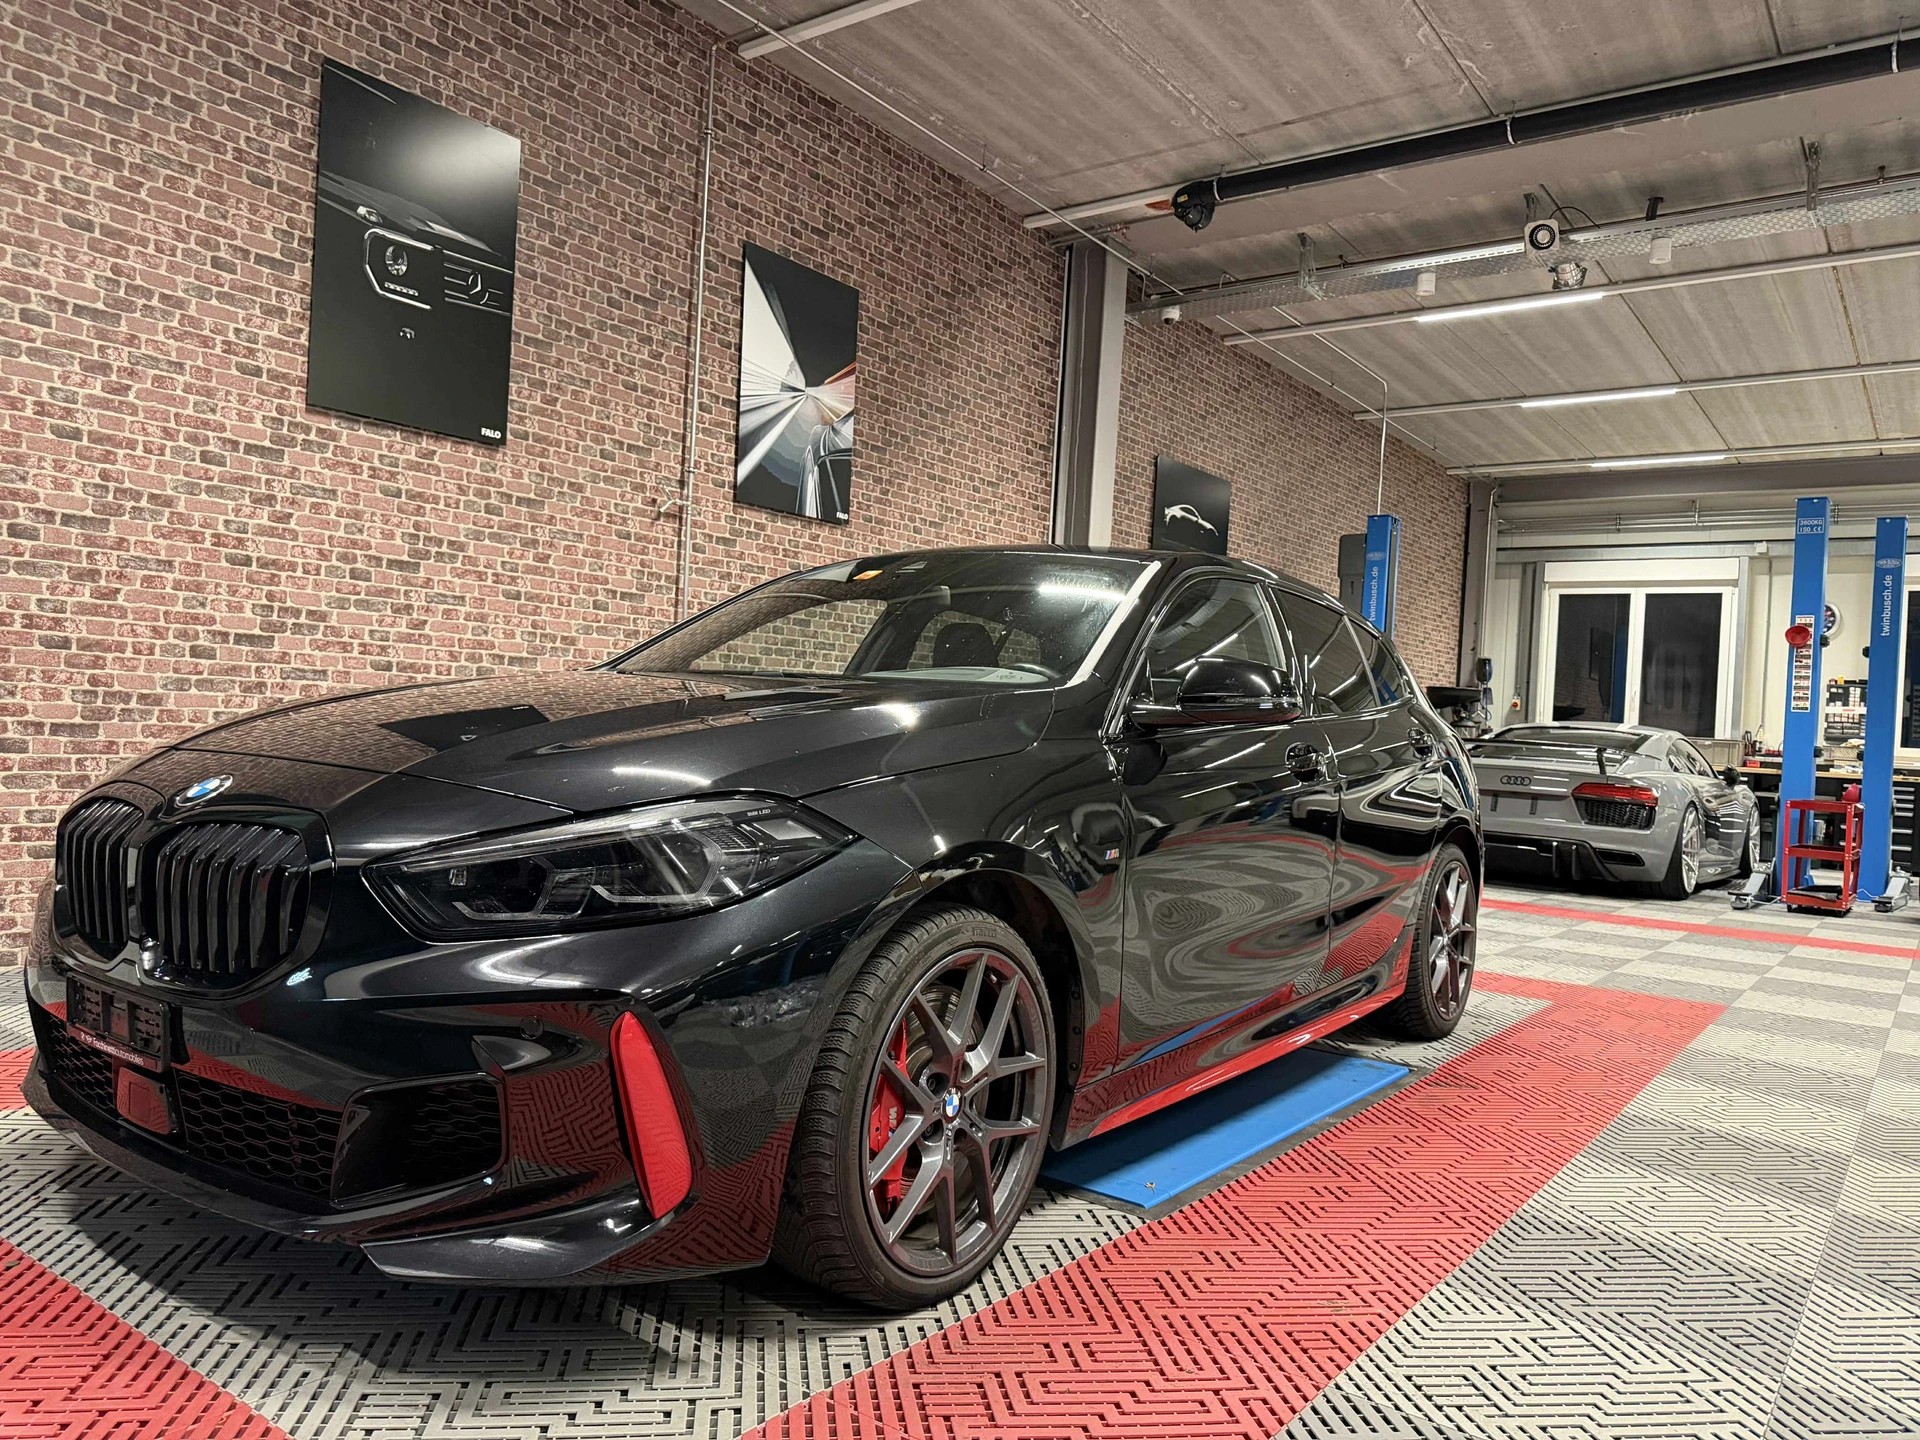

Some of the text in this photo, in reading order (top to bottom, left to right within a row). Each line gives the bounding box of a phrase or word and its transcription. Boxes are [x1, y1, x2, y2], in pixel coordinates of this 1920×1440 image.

[481, 427, 501, 439] FALO
[1370, 566, 1379, 621] twinbusch.de
[1880, 574, 1893, 637] twinbusch.de
